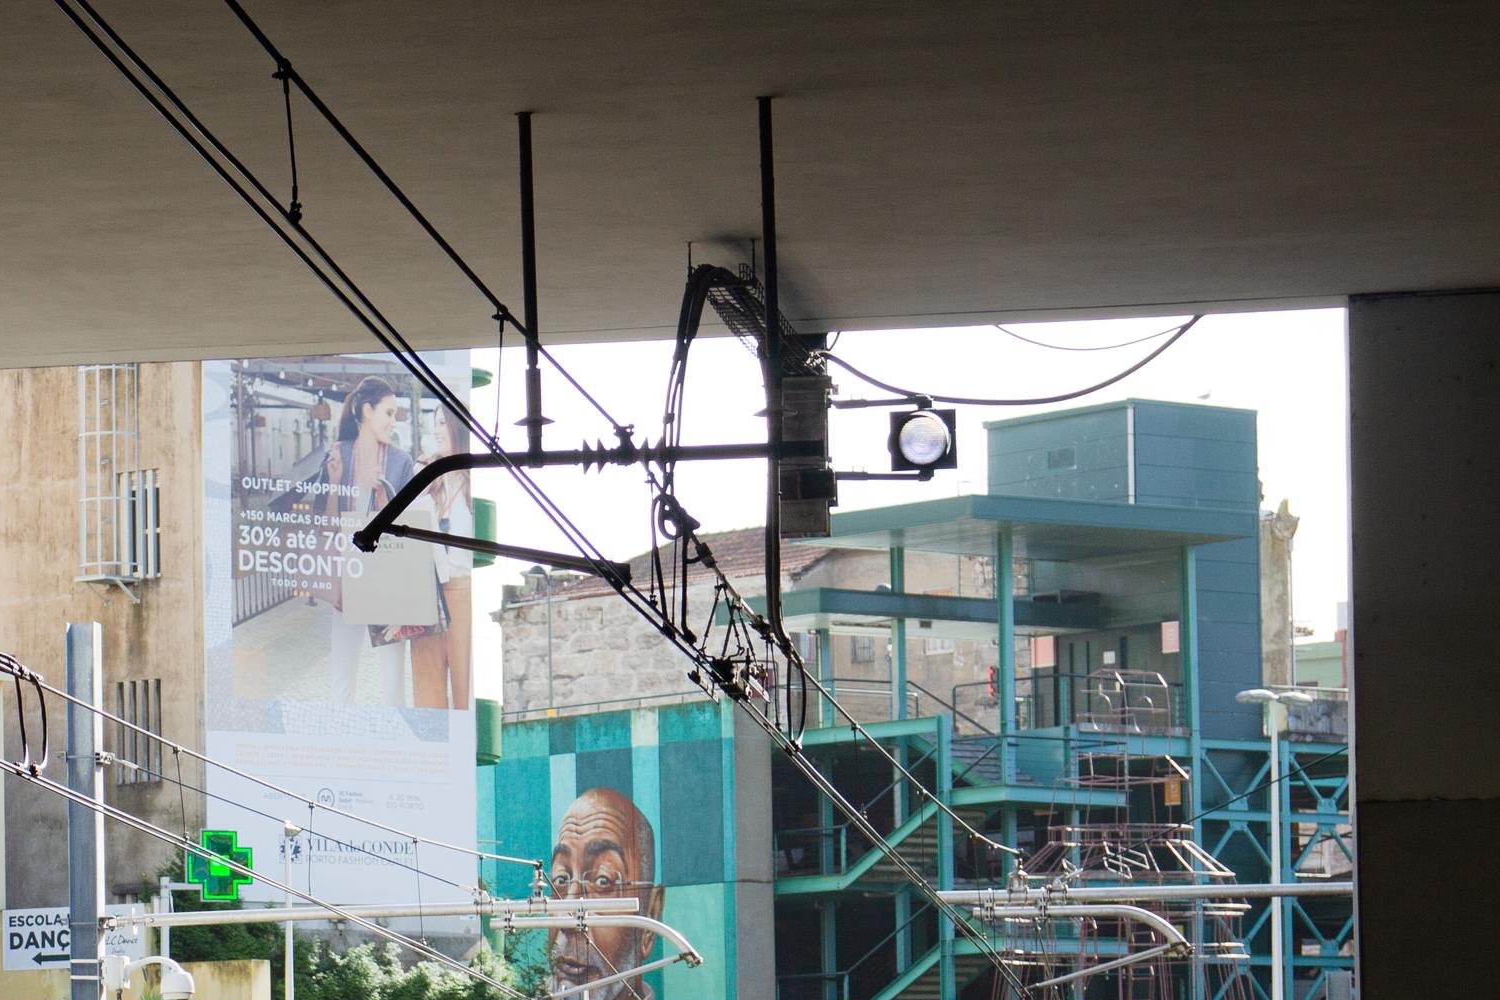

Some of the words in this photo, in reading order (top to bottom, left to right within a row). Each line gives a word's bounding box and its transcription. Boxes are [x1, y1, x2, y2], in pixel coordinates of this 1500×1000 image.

[241, 476, 292, 492] OUTLET
[295, 480, 361, 497] SHOPPING
[240, 510, 264, 522] +150
[266, 511, 311, 525] MARCAS
[314, 514, 329, 526] DE
[330, 515, 363, 528] MODA
[238, 525, 281, 547] 30%
[286, 529, 317, 549] até
[238, 548, 364, 578] DESCONTO
[271, 577, 298, 589] TODO
[301, 580, 309, 588] O
[312, 581, 333, 591] ANO
[306, 838, 345, 853] VILA
[361, 841, 414, 855] CONDE
[305, 854, 337, 865] PORTO
[8, 913, 63, 928] ESCOLA
